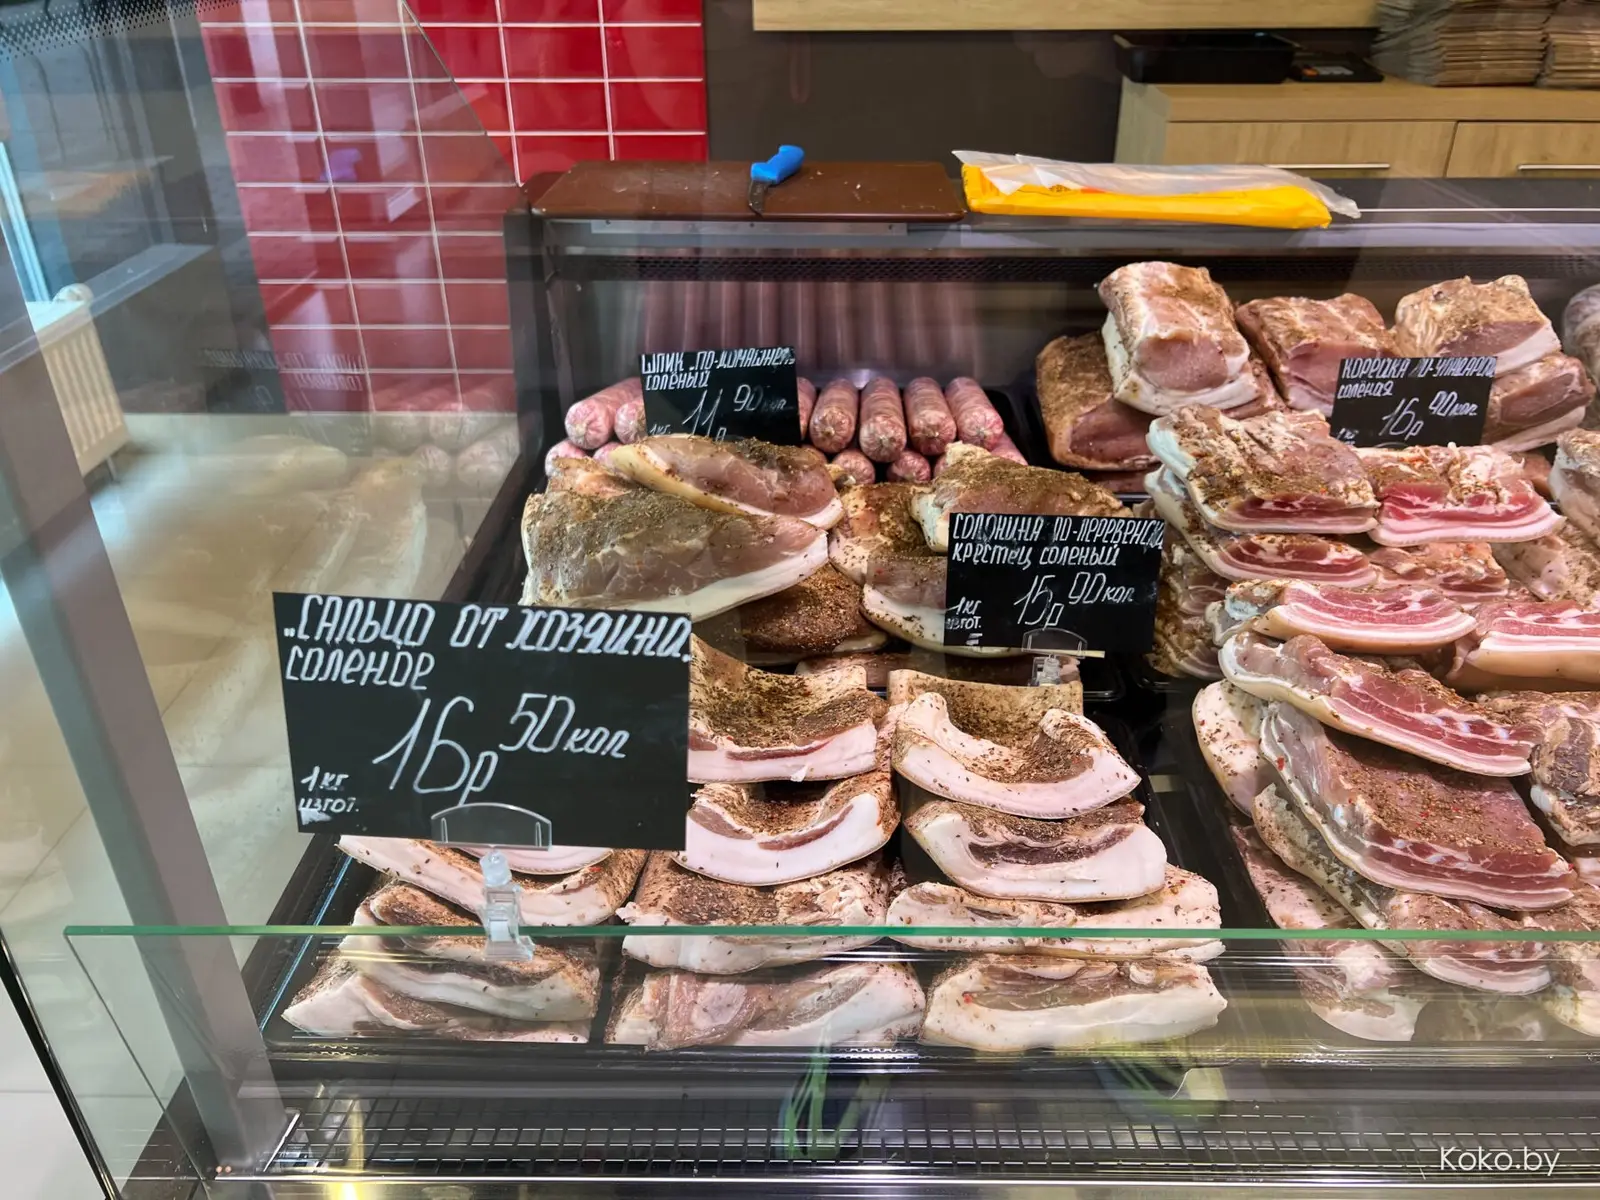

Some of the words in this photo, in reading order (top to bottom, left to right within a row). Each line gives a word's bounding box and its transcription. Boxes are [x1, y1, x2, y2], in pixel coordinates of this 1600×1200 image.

[641, 352, 684, 375] ШПИК
[953, 513, 1045, 542] СОЛОНИНА
[449, 604, 509, 649] ОТ
